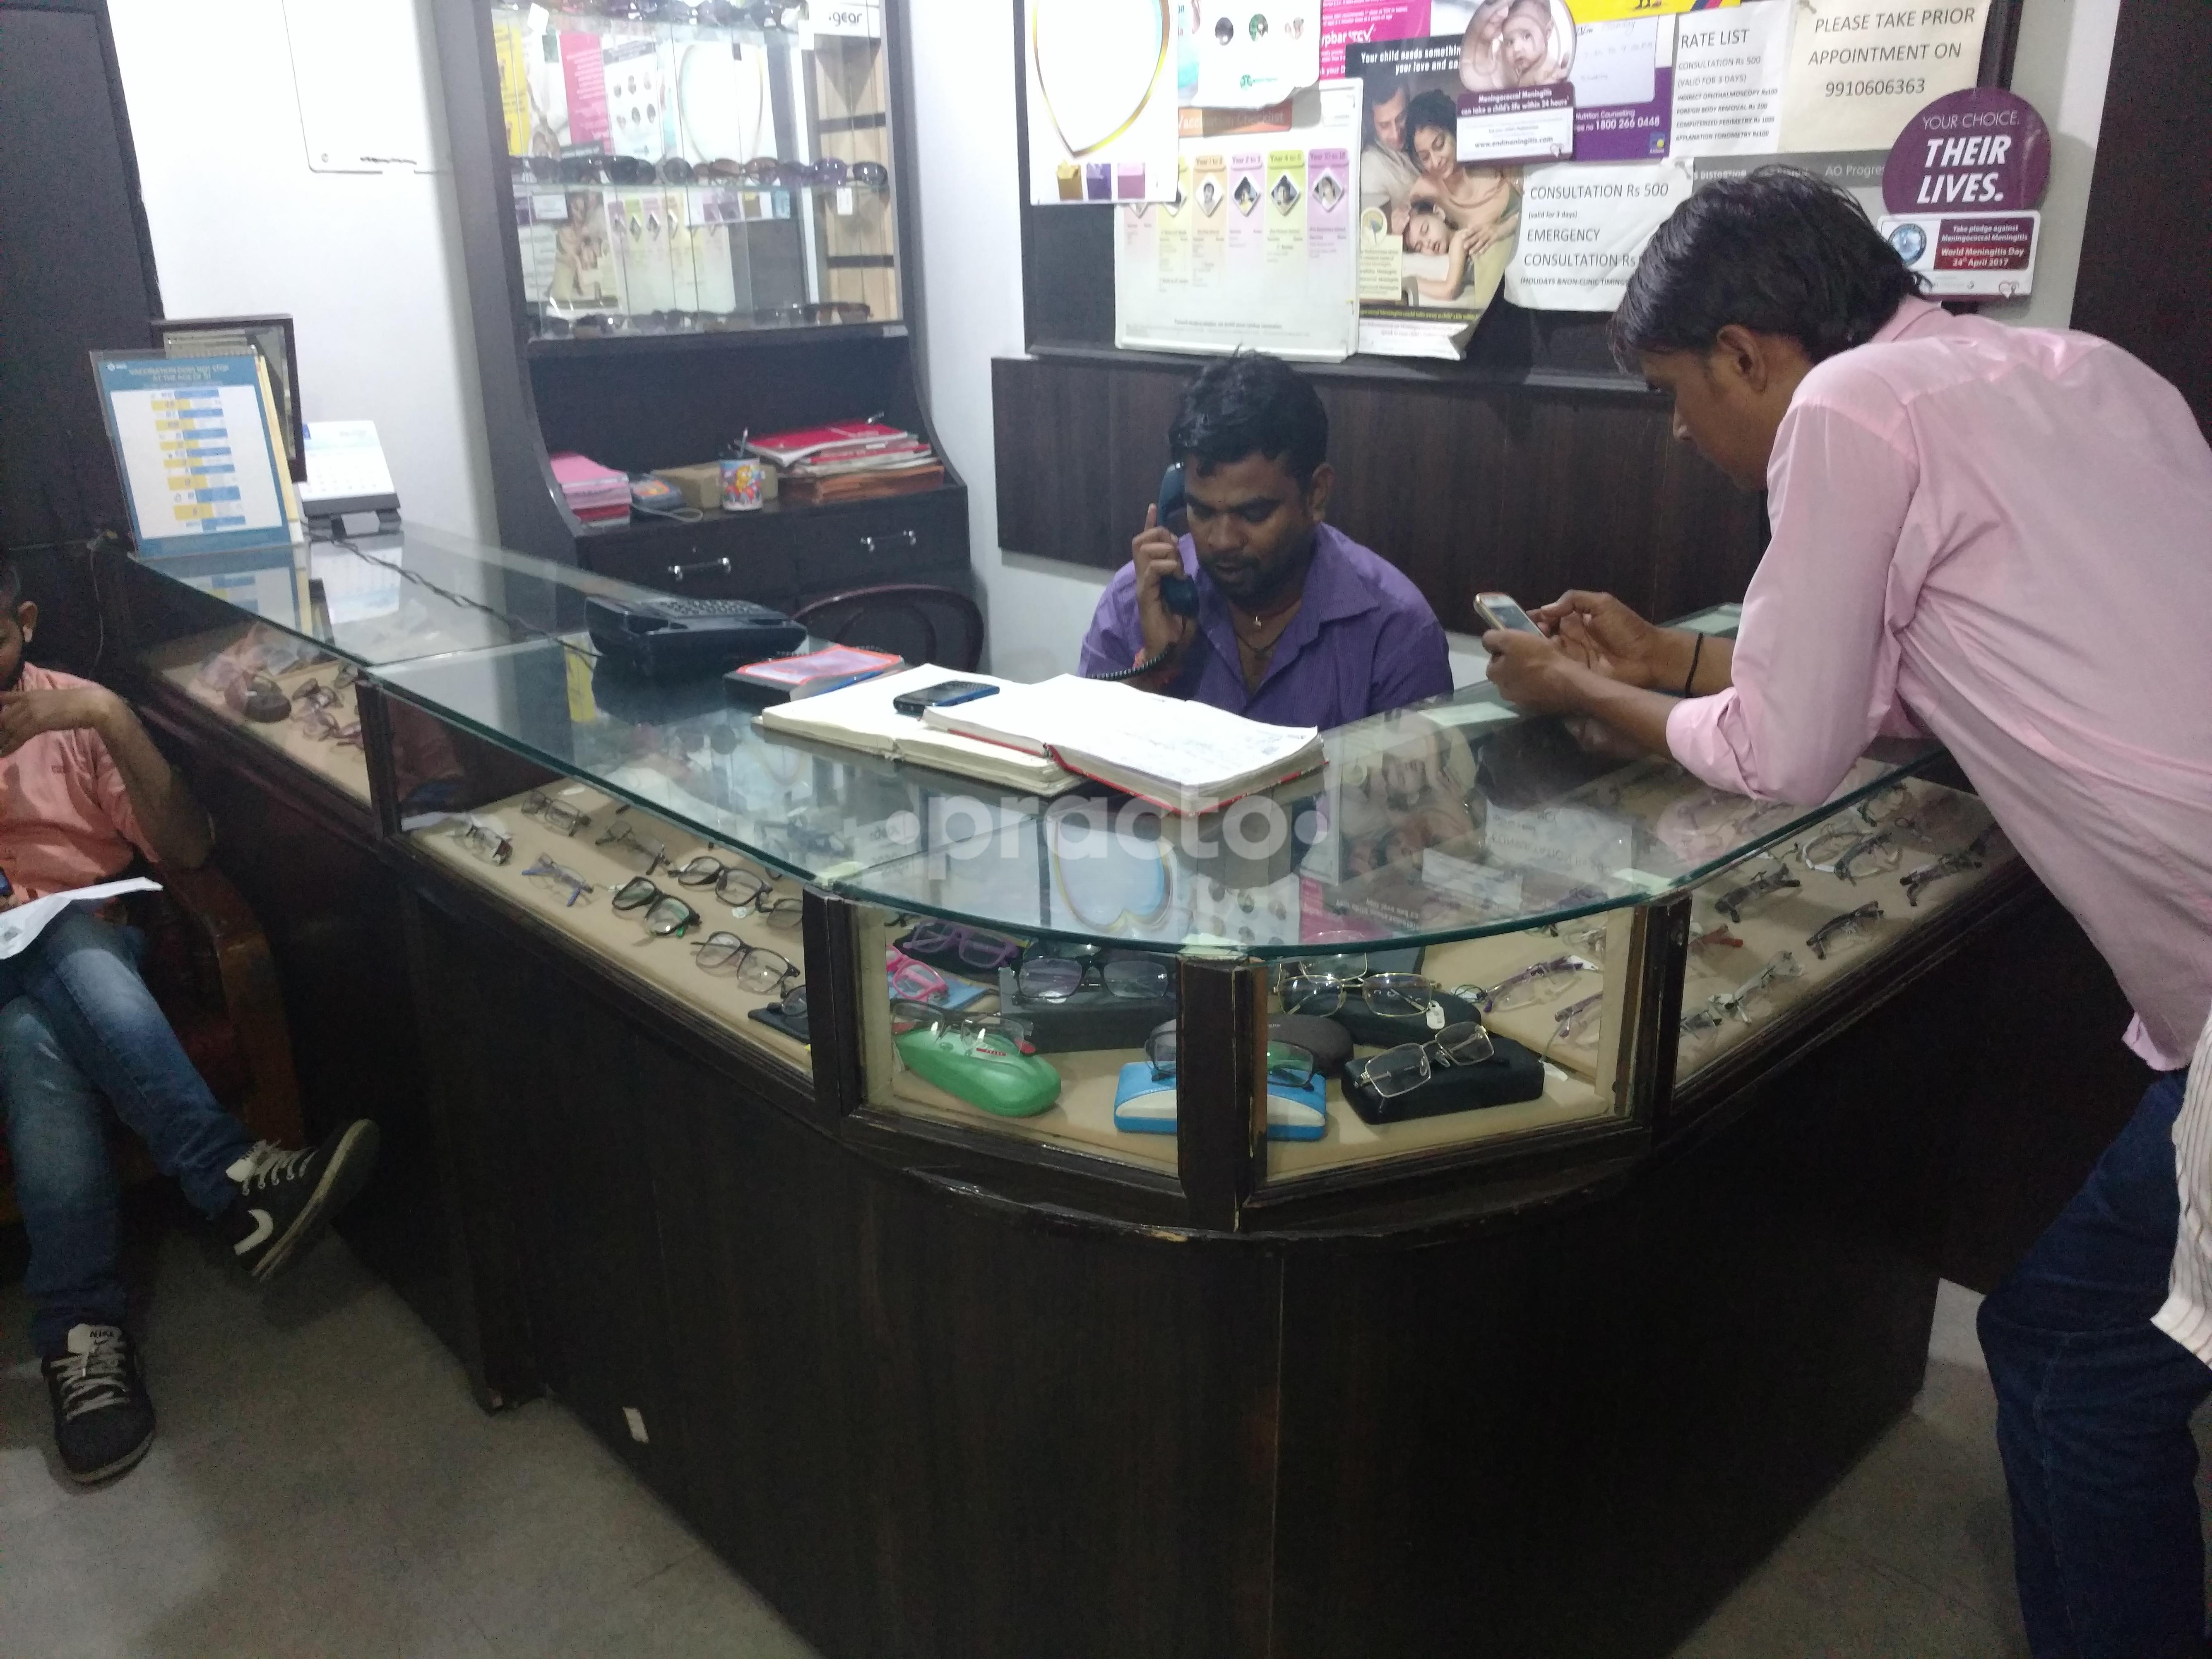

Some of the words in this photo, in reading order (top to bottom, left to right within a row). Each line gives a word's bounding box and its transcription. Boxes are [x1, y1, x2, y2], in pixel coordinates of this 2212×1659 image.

[1815, 14, 1871, 33] PLEASE
[1876, 10, 1916, 29] TAKE
[1922, 7, 1975, 26] PRIOR
[1681, 31, 1715, 49] RATE
[1720, 29, 1750, 46] LIST
[1361, 51, 1378, 64] Your
[1380, 49, 1399, 62] child
[1401, 47, 1423, 60] needs
[1808, 43, 1930, 65] APPOINTMENT
[1934, 42, 1962, 59] ON
[1395, 63, 1411, 76] your
[1413, 60, 1429, 72] love
[1431, 58, 1446, 71] and
[1679, 59, 1734, 70] CONSULTATION
[1747, 56, 1761, 65] 500
[1678, 78, 1700, 88] (VALID
[1702, 77, 1716, 85] FOR
[1724, 74, 1746, 83] DAYS)
[1825, 77, 1926, 97] 9910606363
[1473, 105, 1486, 113] take
[1511, 101, 1520, 111] life
[1522, 100, 1540, 110] within
[1576, 112, 1599, 120] Nutrition
[1923, 114, 1958, 130] YOUR
[1596, 119, 1617, 130] 1800
[1618, 118, 1635, 129] 266
[1925, 135, 2012, 168] THEIR
[1825, 166, 1842, 177] AO
[1530, 184, 1622, 200] CONSULTATION
[1627, 184, 1640, 197] Rs
[1644, 183, 1669, 197] 500
[1917, 171, 2003, 204] LIVES.
[1529, 211, 1544, 219] (valid
[1561, 211, 1577, 219] days)
[1527, 228, 1600, 242] EMERGENCY
[1969, 225, 1992, 234] pledge
[1993, 224, 2019, 233] against
[1941, 247, 1963, 256] World
[1965, 247, 2006, 257] Meningitis
[2008, 247, 2024, 257] Day
[1524, 253, 1618, 267] CONSULTATION
[1623, 253, 1635, 267] Rs
[1967, 257, 1987, 267] April
[1988, 257, 2009, 266] 2017
[1520, 277, 1555, 286] (HOLIDAYS
